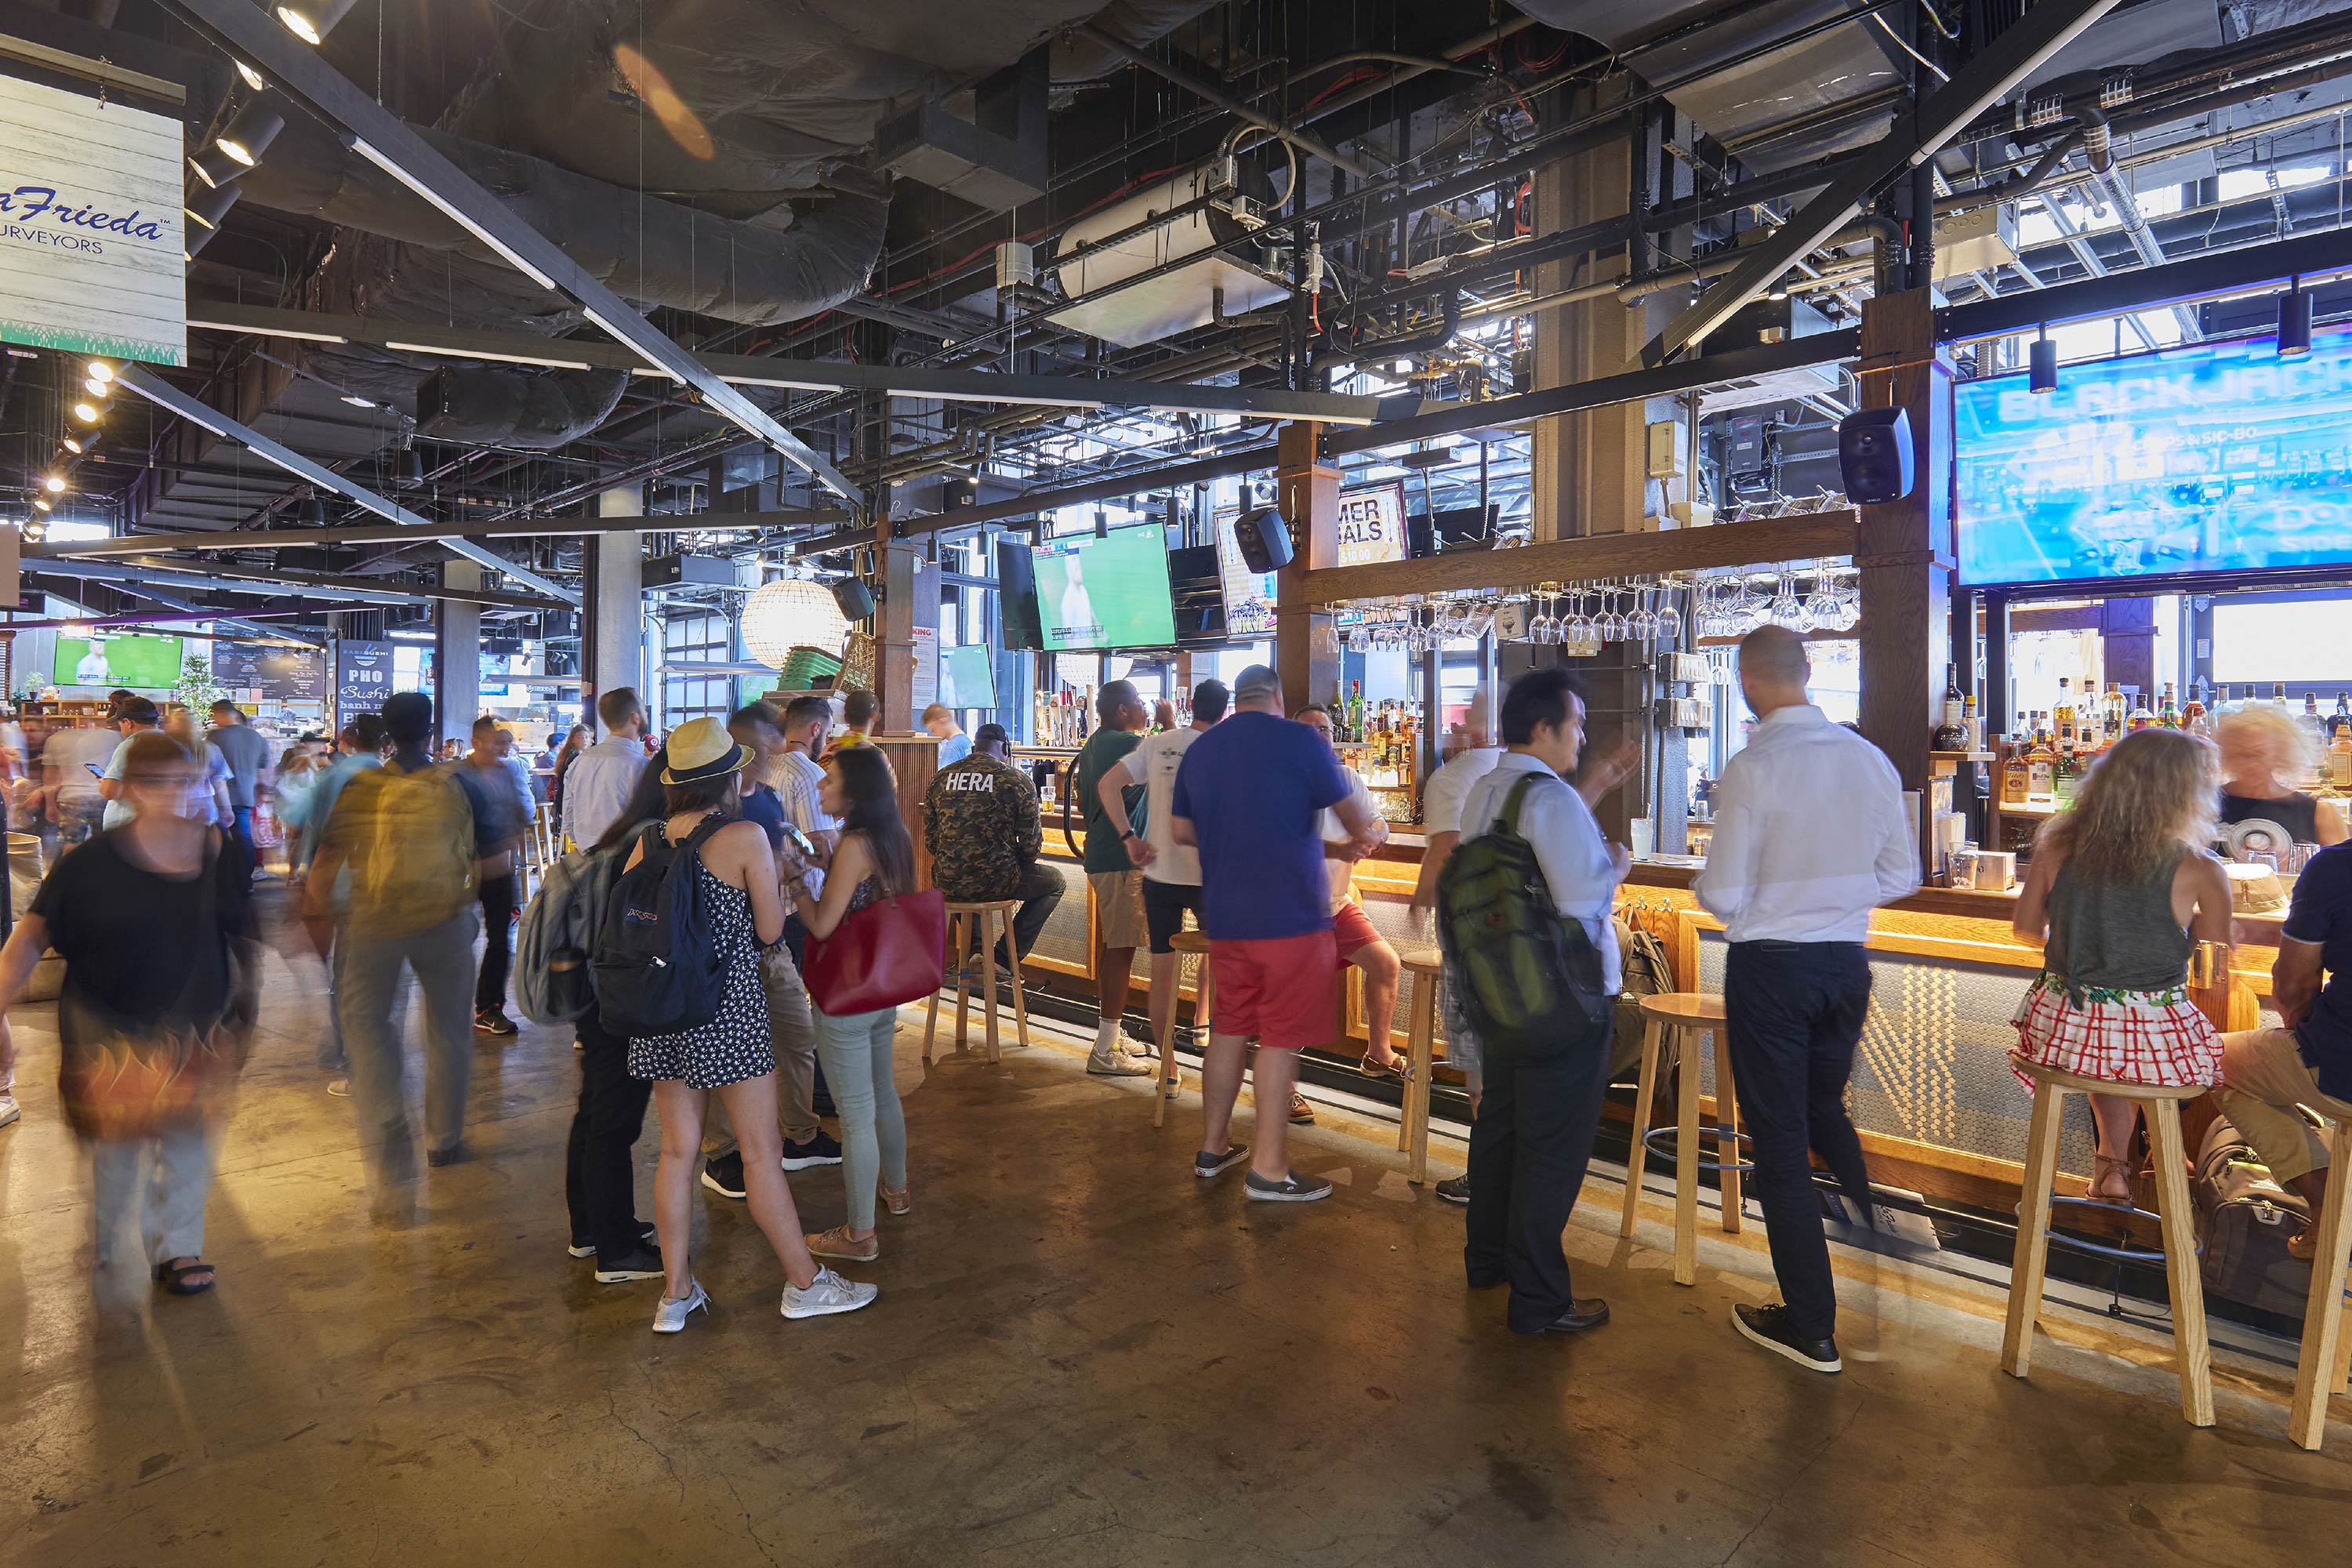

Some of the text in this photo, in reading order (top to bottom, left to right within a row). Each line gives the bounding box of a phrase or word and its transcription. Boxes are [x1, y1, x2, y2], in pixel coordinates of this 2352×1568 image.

[348, 669, 383, 683] PHO
[339, 685, 390, 699] Sushi
[339, 700, 372, 710] banh
[946, 772, 993, 793] HERA
